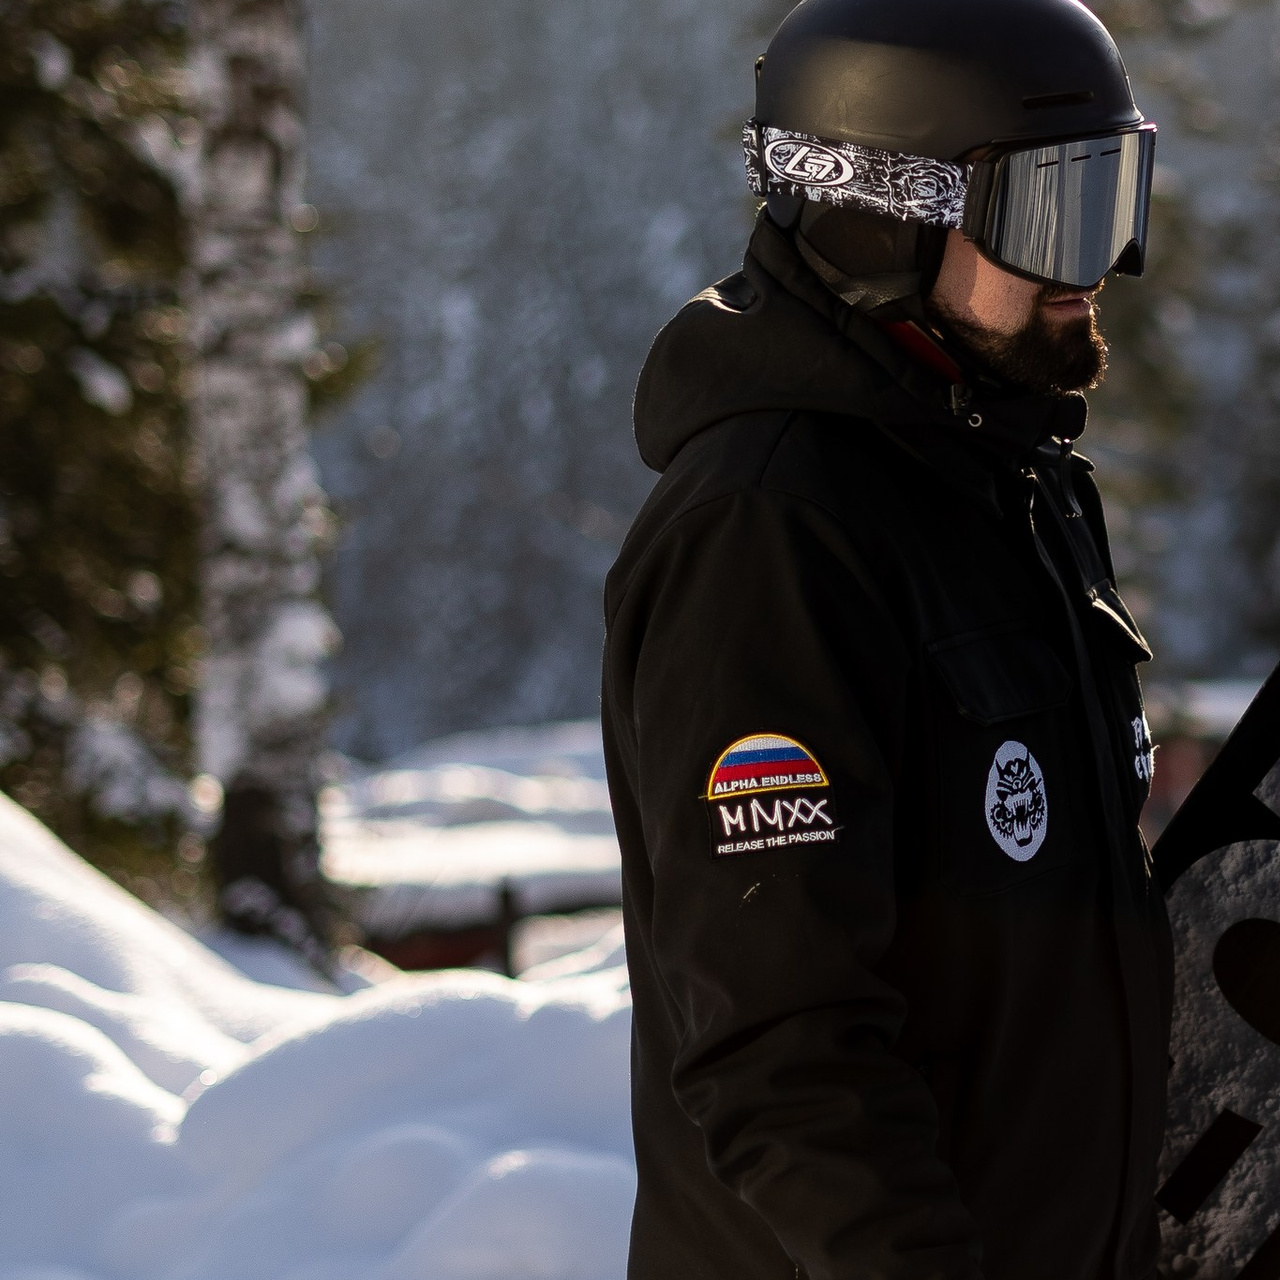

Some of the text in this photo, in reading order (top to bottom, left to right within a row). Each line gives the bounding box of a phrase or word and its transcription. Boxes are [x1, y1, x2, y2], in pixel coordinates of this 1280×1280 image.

[714, 773, 822, 794] ALPHA ENDLESS
[719, 798, 833, 836] MMXX
[718, 830, 835, 854] RELEASE THE PASSION
